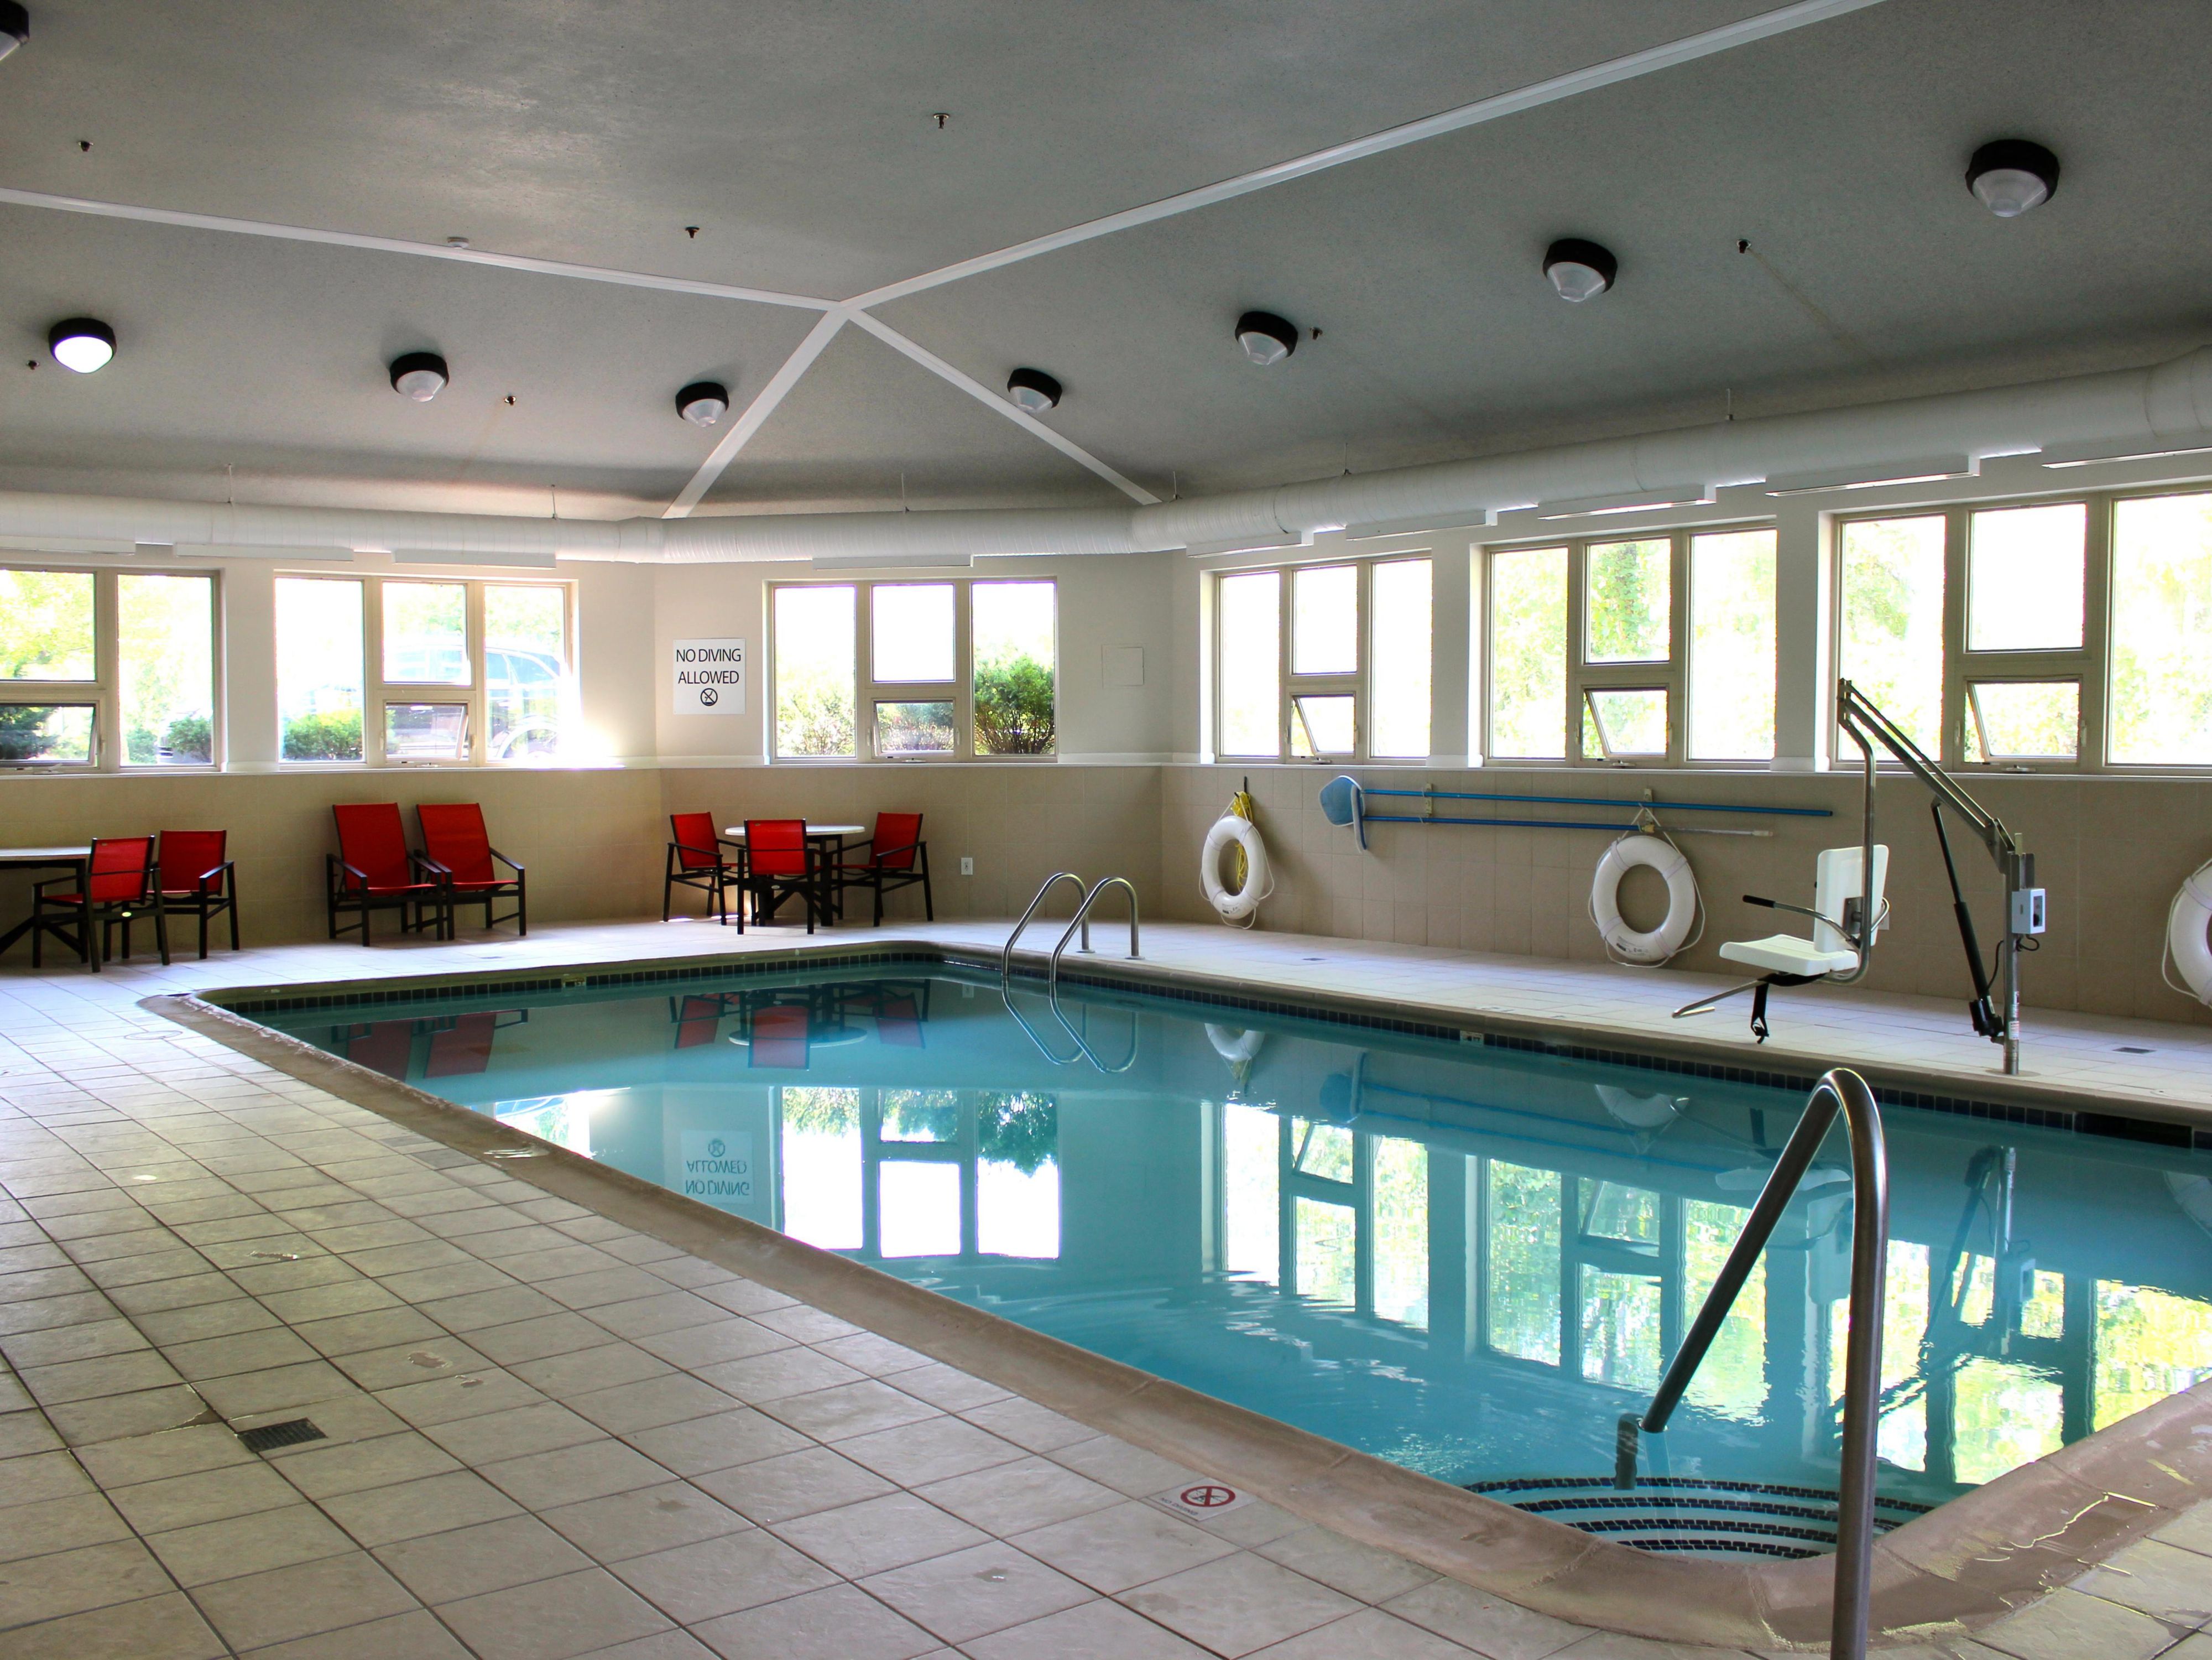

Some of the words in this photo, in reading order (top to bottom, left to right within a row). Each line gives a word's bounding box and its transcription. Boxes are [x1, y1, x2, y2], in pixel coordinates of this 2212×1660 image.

[676, 649, 696, 662] NO
[698, 648, 741, 662] DIVING
[678, 670, 739, 684] ALLOWED
